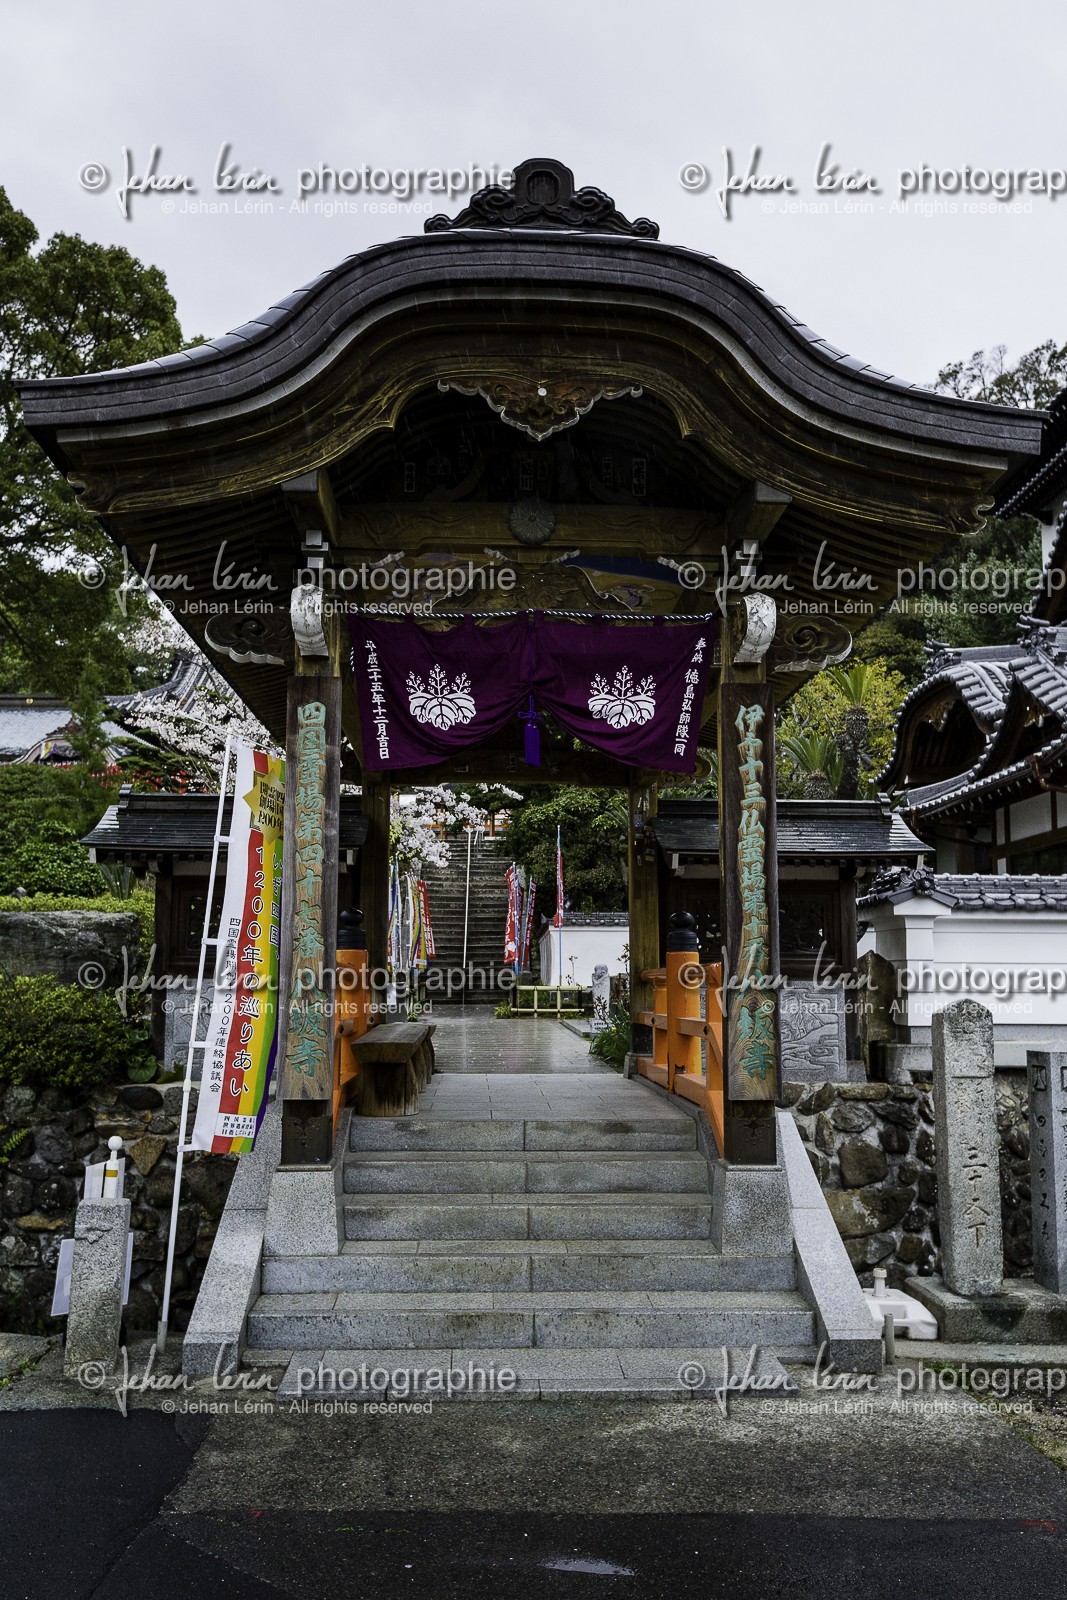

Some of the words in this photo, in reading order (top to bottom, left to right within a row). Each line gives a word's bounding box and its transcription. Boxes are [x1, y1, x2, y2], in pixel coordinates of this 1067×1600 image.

[364, 640, 390, 760] 平成二十五年十二月吉日
